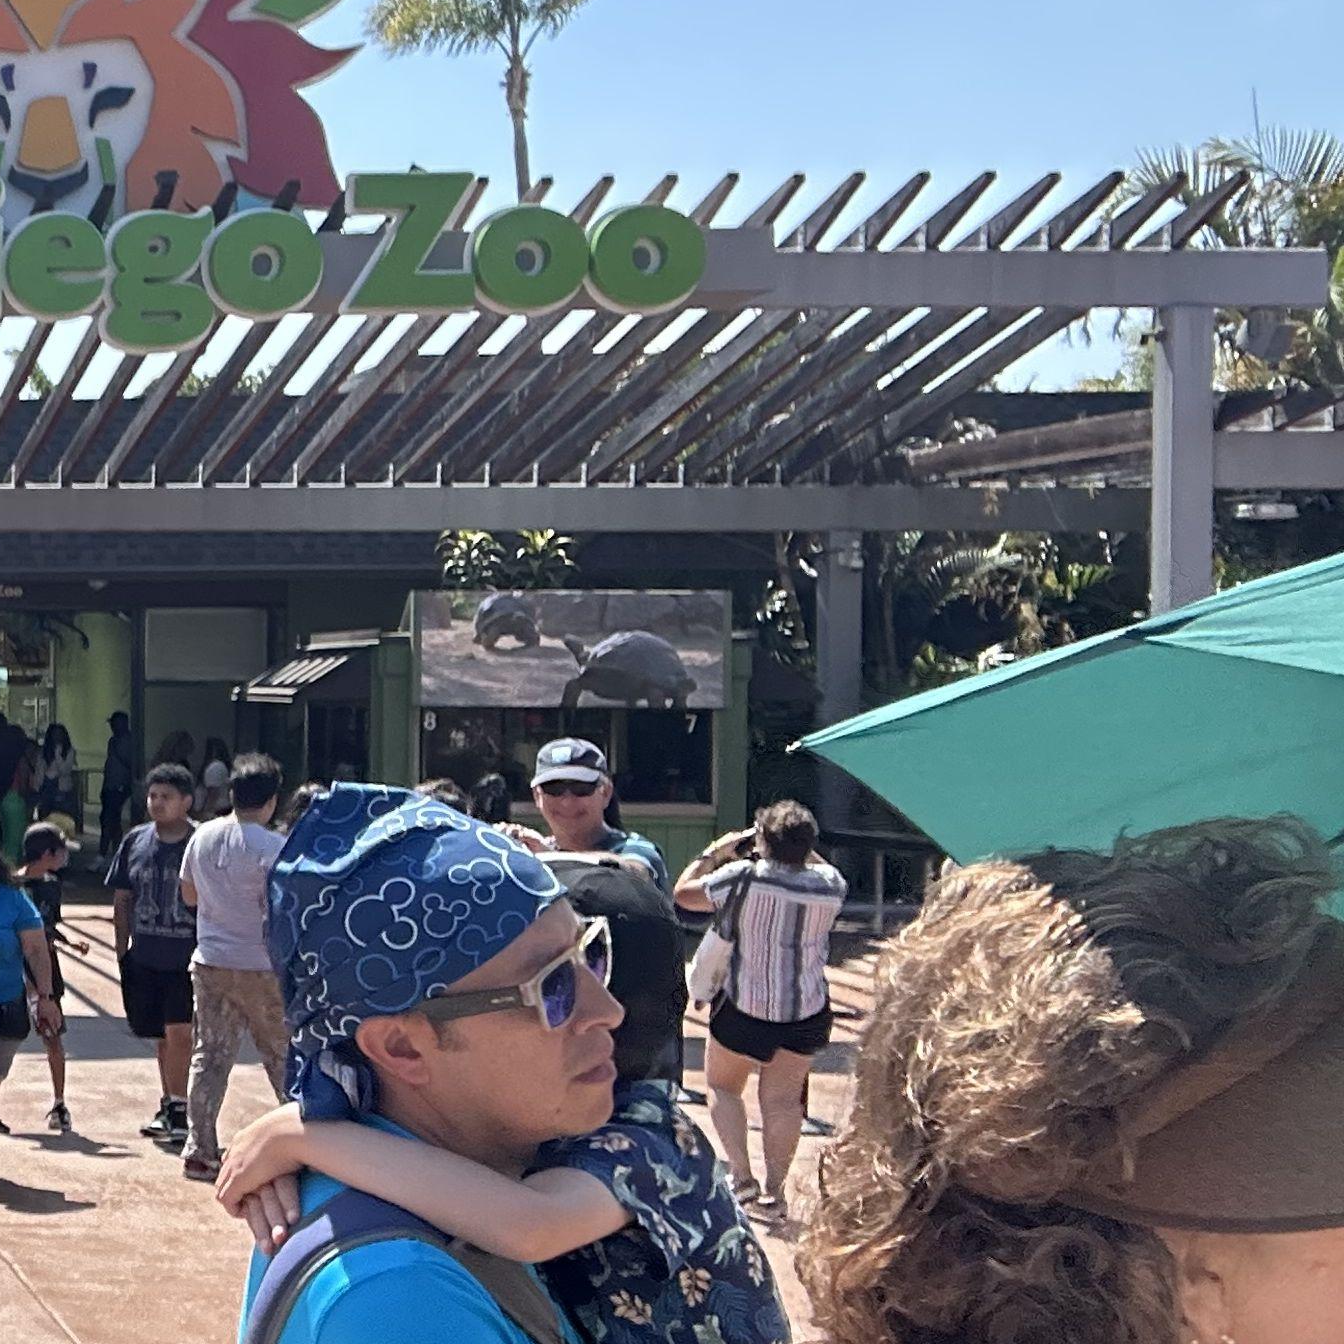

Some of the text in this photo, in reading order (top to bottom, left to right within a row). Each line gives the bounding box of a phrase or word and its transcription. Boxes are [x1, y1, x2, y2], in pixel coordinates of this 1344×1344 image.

[340, 172, 708, 316] Zoo
[423, 710, 437, 732] 8
[685, 712, 698, 734] 7
